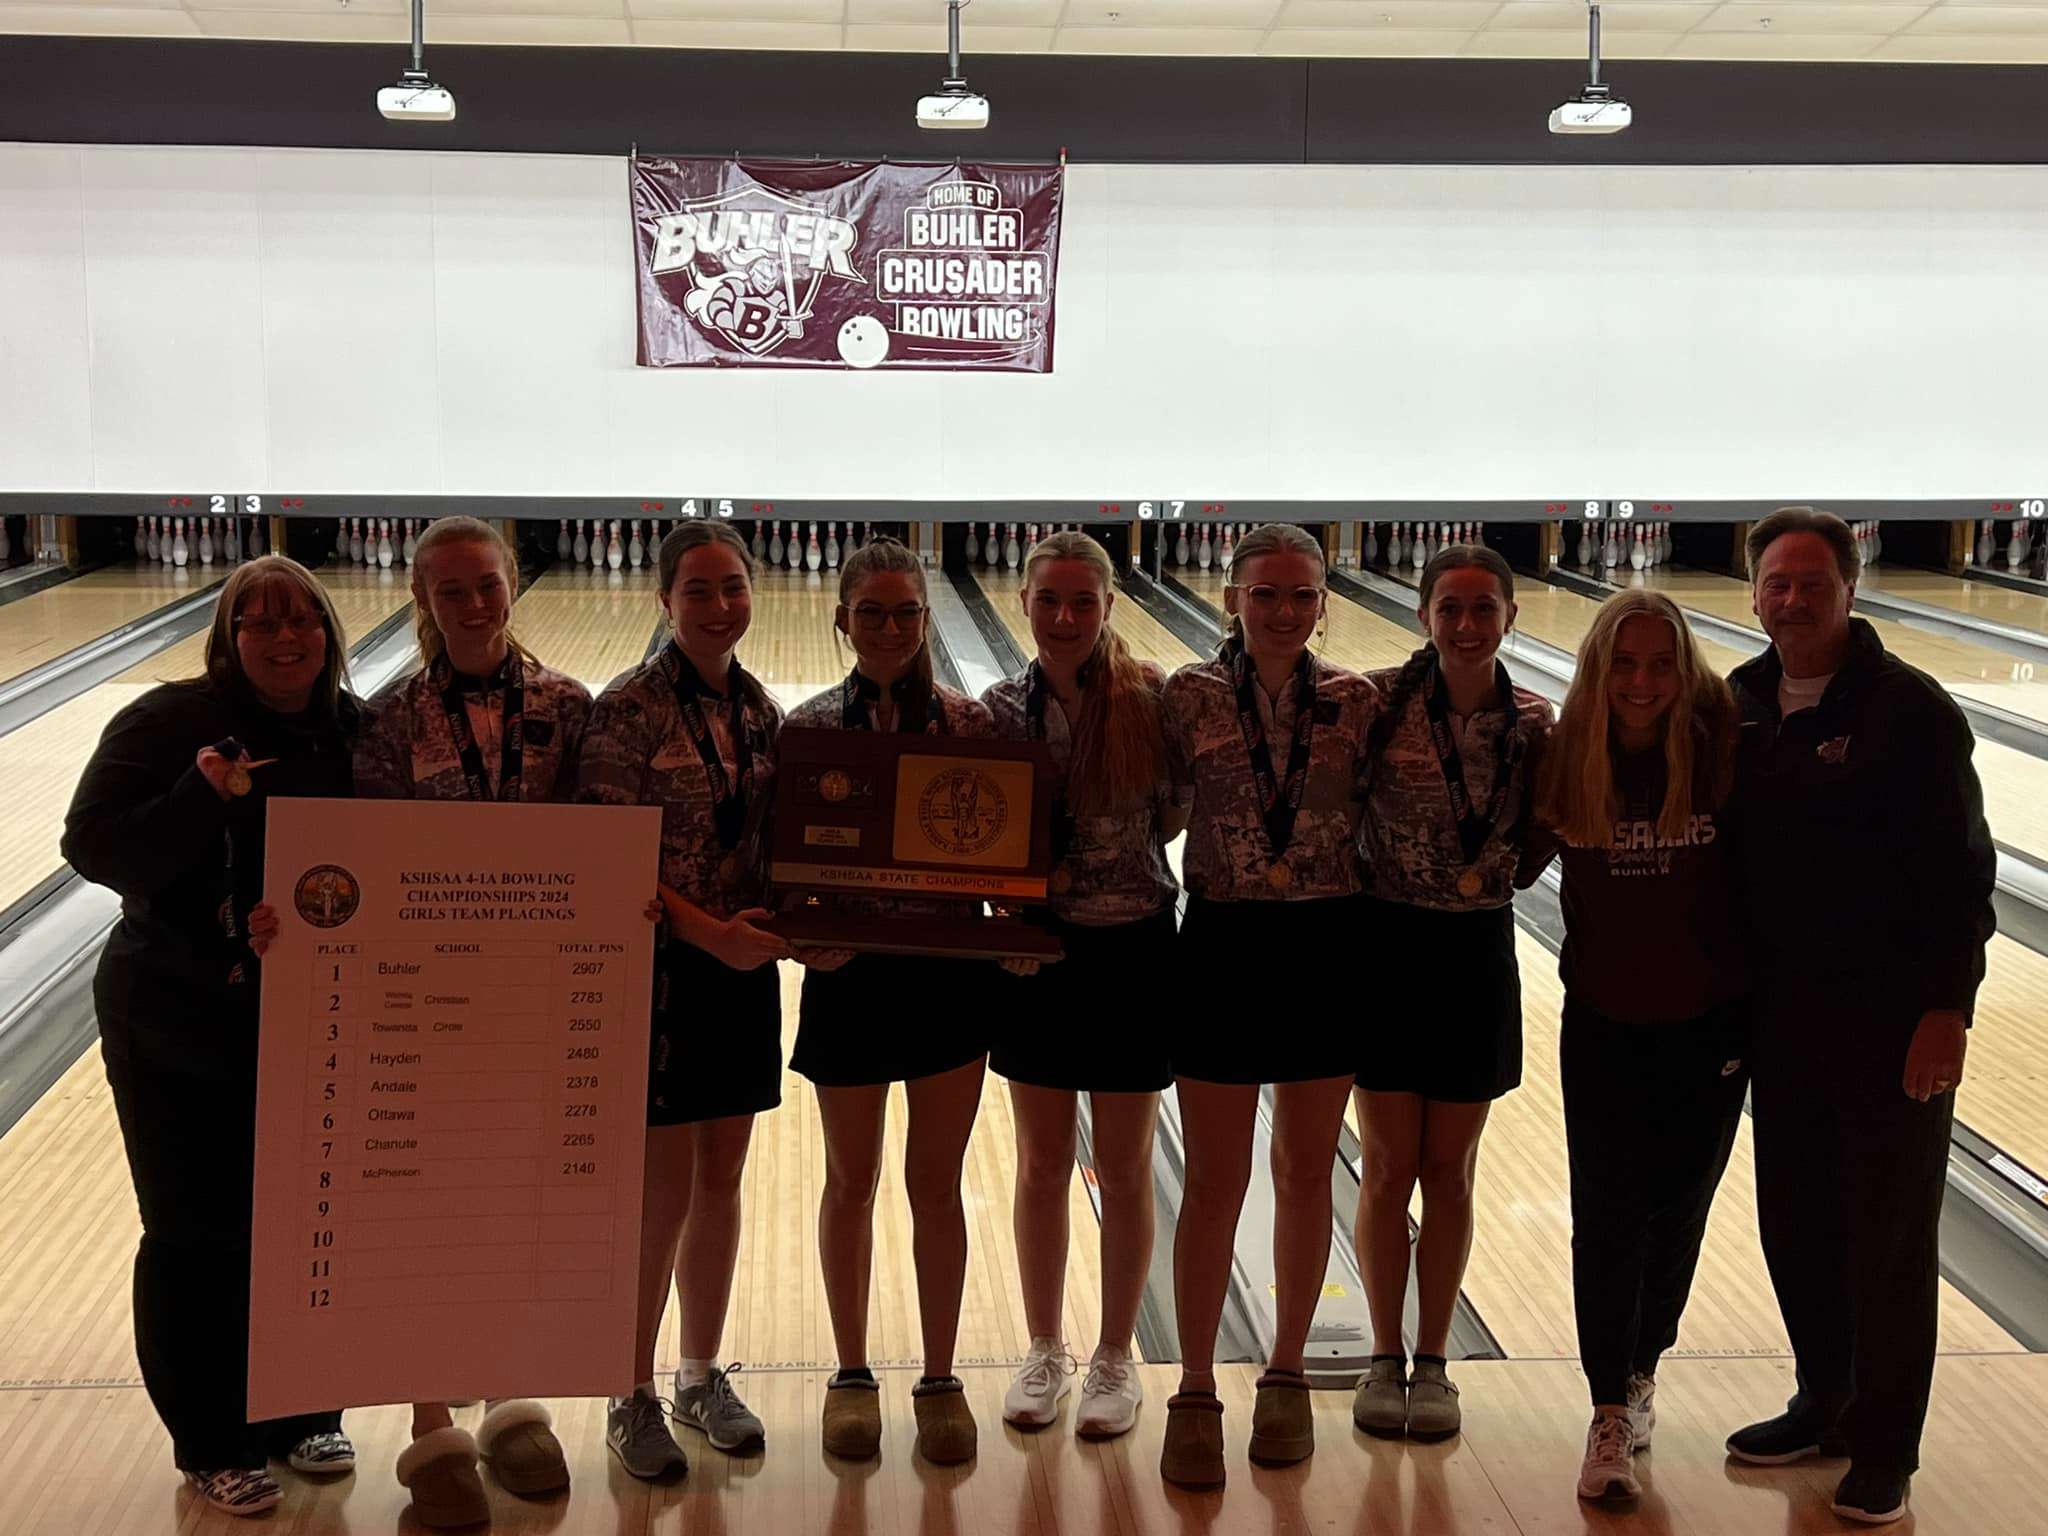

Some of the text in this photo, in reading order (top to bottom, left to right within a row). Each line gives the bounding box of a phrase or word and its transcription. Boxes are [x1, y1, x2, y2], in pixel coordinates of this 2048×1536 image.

[935, 186, 995, 204] HOME OF
[911, 213, 1016, 248] BUHLER
[652, 209, 862, 276] BUHLER
[883, 257, 1043, 295] CRUSADER
[737, 302, 772, 340] B
[903, 306, 1024, 340] BOWLING
[210, 495, 226, 513] 2
[246, 495, 261, 513] 3
[681, 499, 697, 517] 4
[718, 499, 734, 517] 5
[1138, 501, 1153, 519] 6
[1170, 500, 1185, 518] 7
[1584, 500, 1600, 519] 8
[1618, 500, 1634, 519] 9
[2019, 500, 2045, 518] 10
[400, 872, 576, 886] KSHSAA 4-1A BOWLING
[820, 868, 1004, 890] KSHSAA STATE CHAMPIONS
[407, 889, 570, 903] CHAMPIONSHIPS 2024
[399, 908, 576, 921] GIRLS TEAM PLACINGS
[317, 944, 359, 955] PLACE
[434, 943, 483, 953] SCHOOL
[556, 943, 625, 953] TOTAL PINS
[332, 964, 341, 982] 1
[378, 961, 422, 977] Buhler
[572, 962, 604, 977] 2907
[328, 992, 341, 1012] 2
[570, 990, 603, 1005] 2783
[327, 1023, 339, 1042] 3
[568, 1018, 602, 1033] 2550
[325, 1052, 337, 1071] 4
[369, 1051, 422, 1068] Hayden
[567, 1046, 600, 1061] 2480
[323, 1082, 336, 1101] 5
[370, 1079, 418, 1094] Andale
[566, 1076, 599, 1090] 2378
[367, 1107, 416, 1122] Ottawa
[564, 1103, 597, 1118] 2278
[322, 1112, 334, 1130] 6
[321, 1141, 333, 1160] 7
[364, 1137, 418, 1151] Chanute
[562, 1162, 596, 1176] 2140
[319, 1171, 332, 1189] 8
[318, 1200, 330, 1218] 9
[312, 1229, 334, 1248] 10
[310, 1259, 330, 1278] 11
[309, 1288, 330, 1308] 12
[752, 1361, 818, 1369] HAZARD
